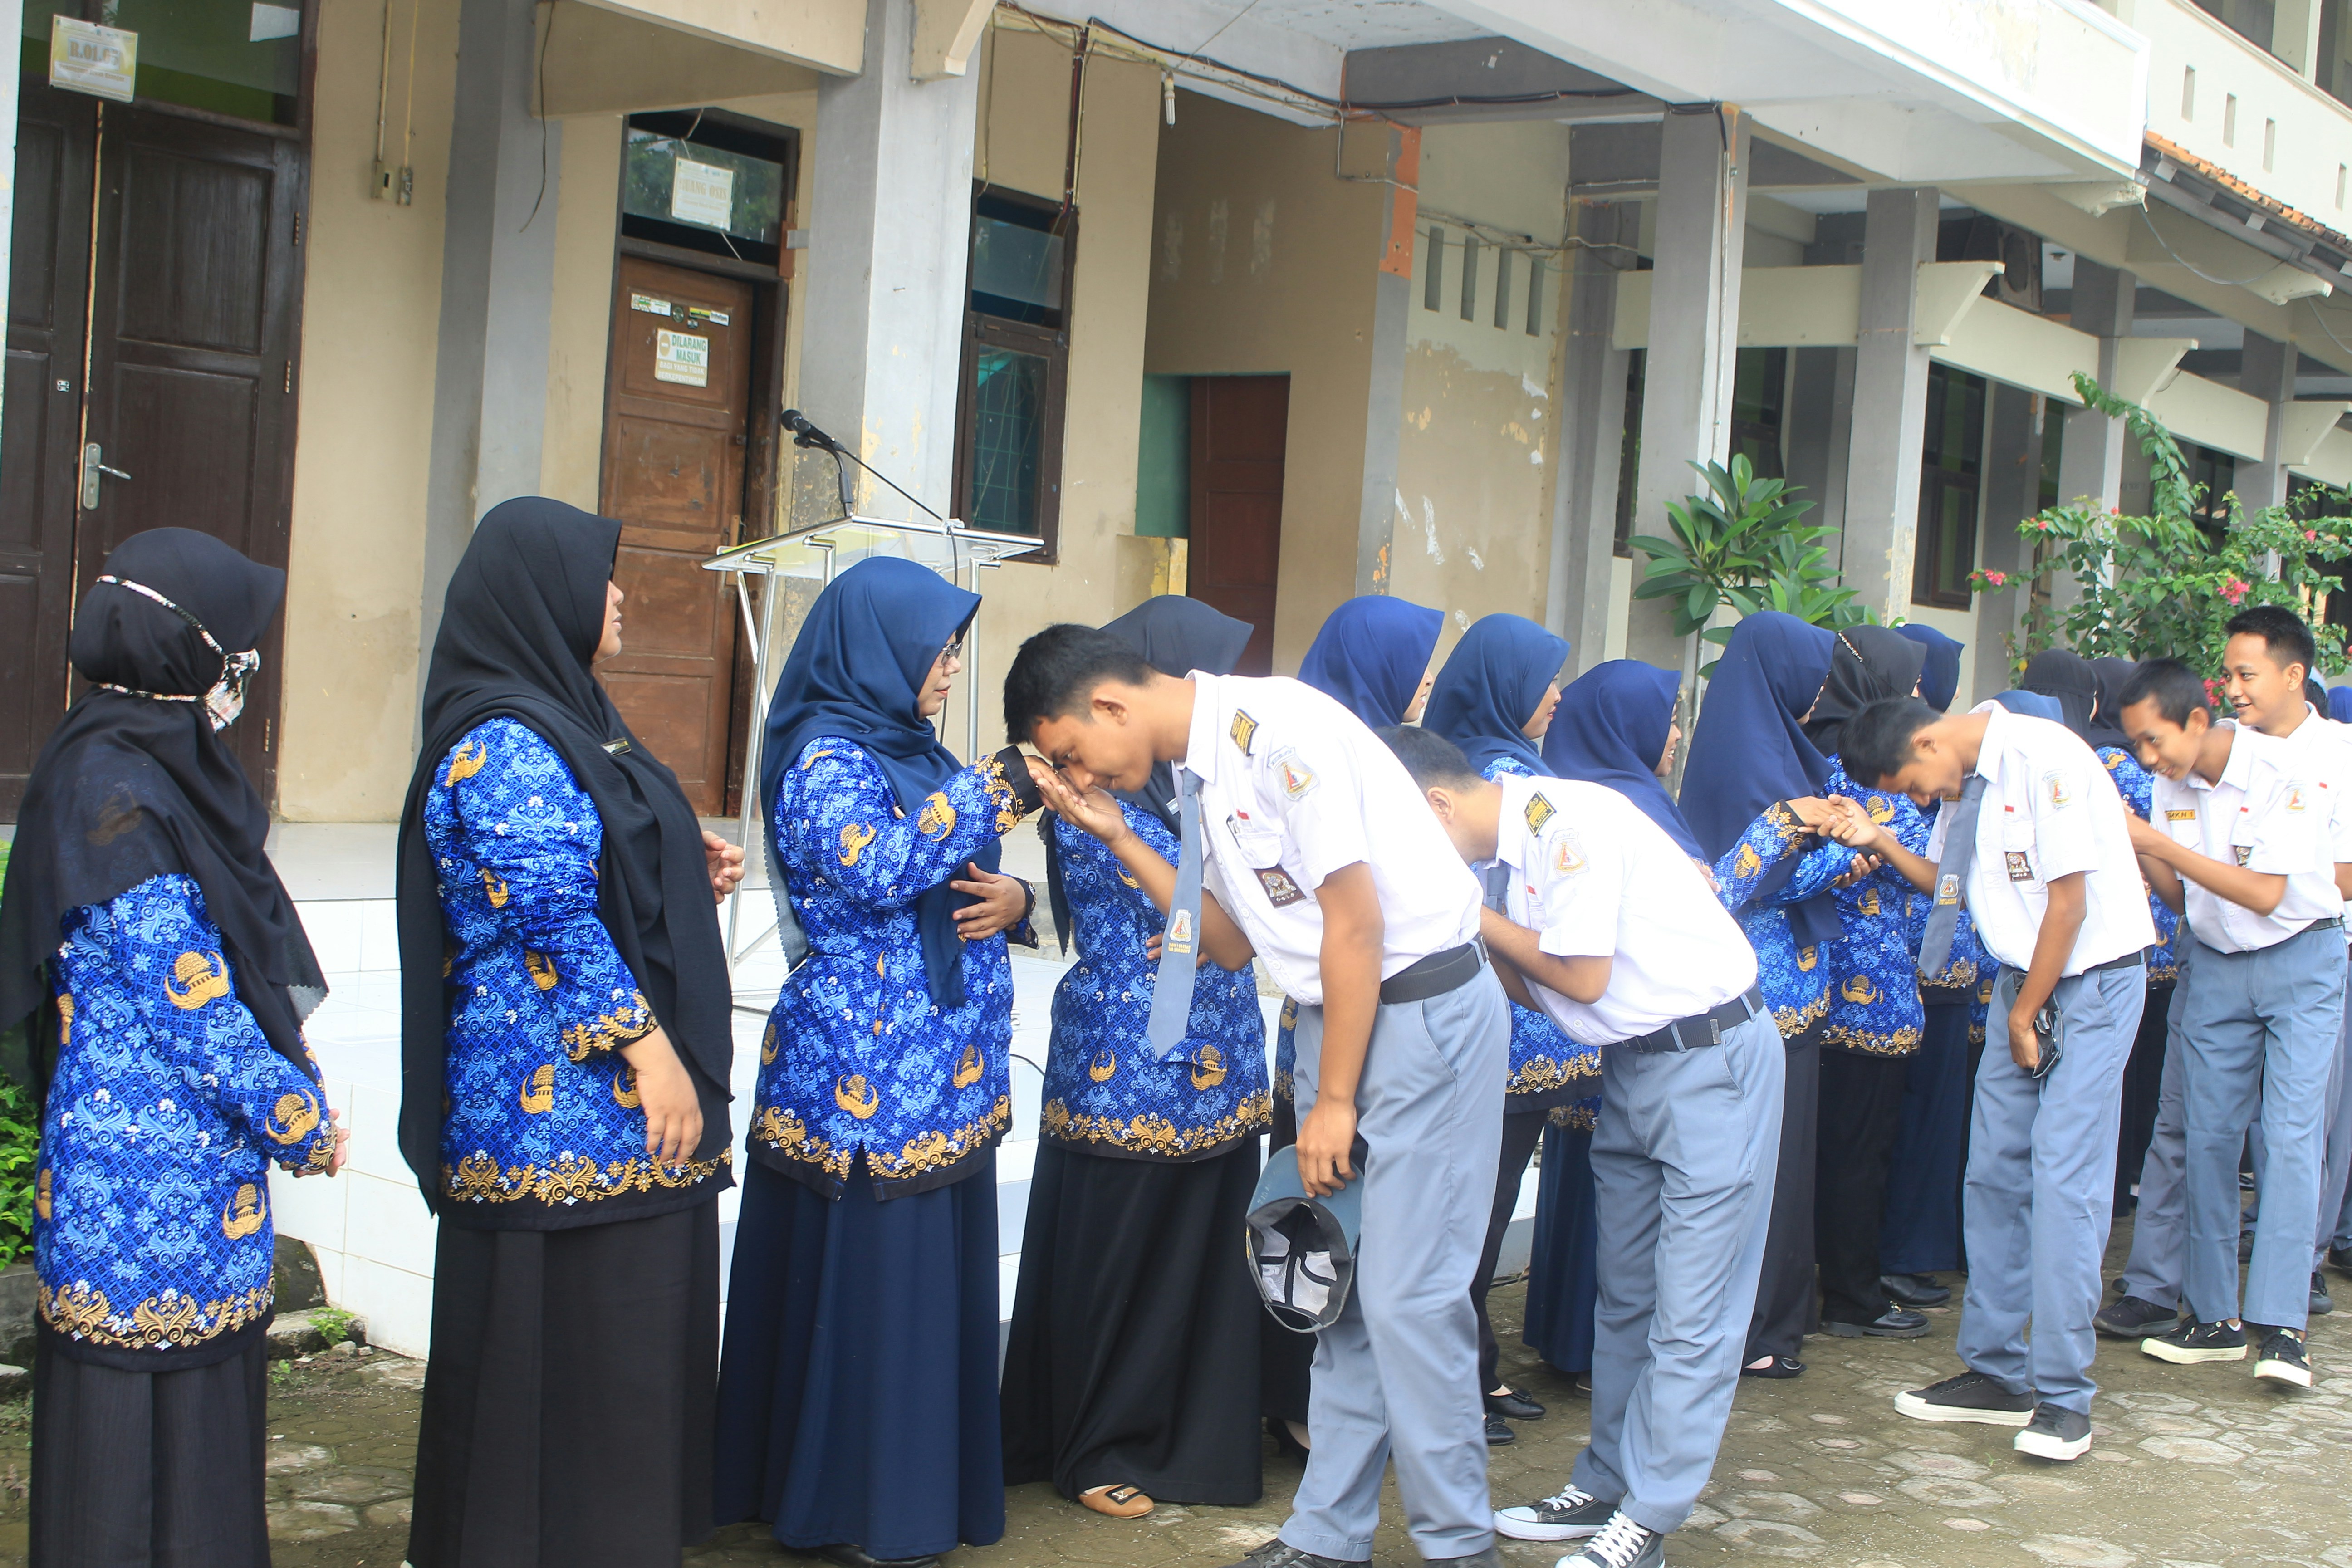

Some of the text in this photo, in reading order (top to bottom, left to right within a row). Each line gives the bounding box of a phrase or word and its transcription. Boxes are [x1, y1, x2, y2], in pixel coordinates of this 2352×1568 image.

[672, 334, 706, 352] DILARANG
[676, 349, 701, 365] MASUK
[660, 361, 704, 375] BAGI YANG TIDAK
